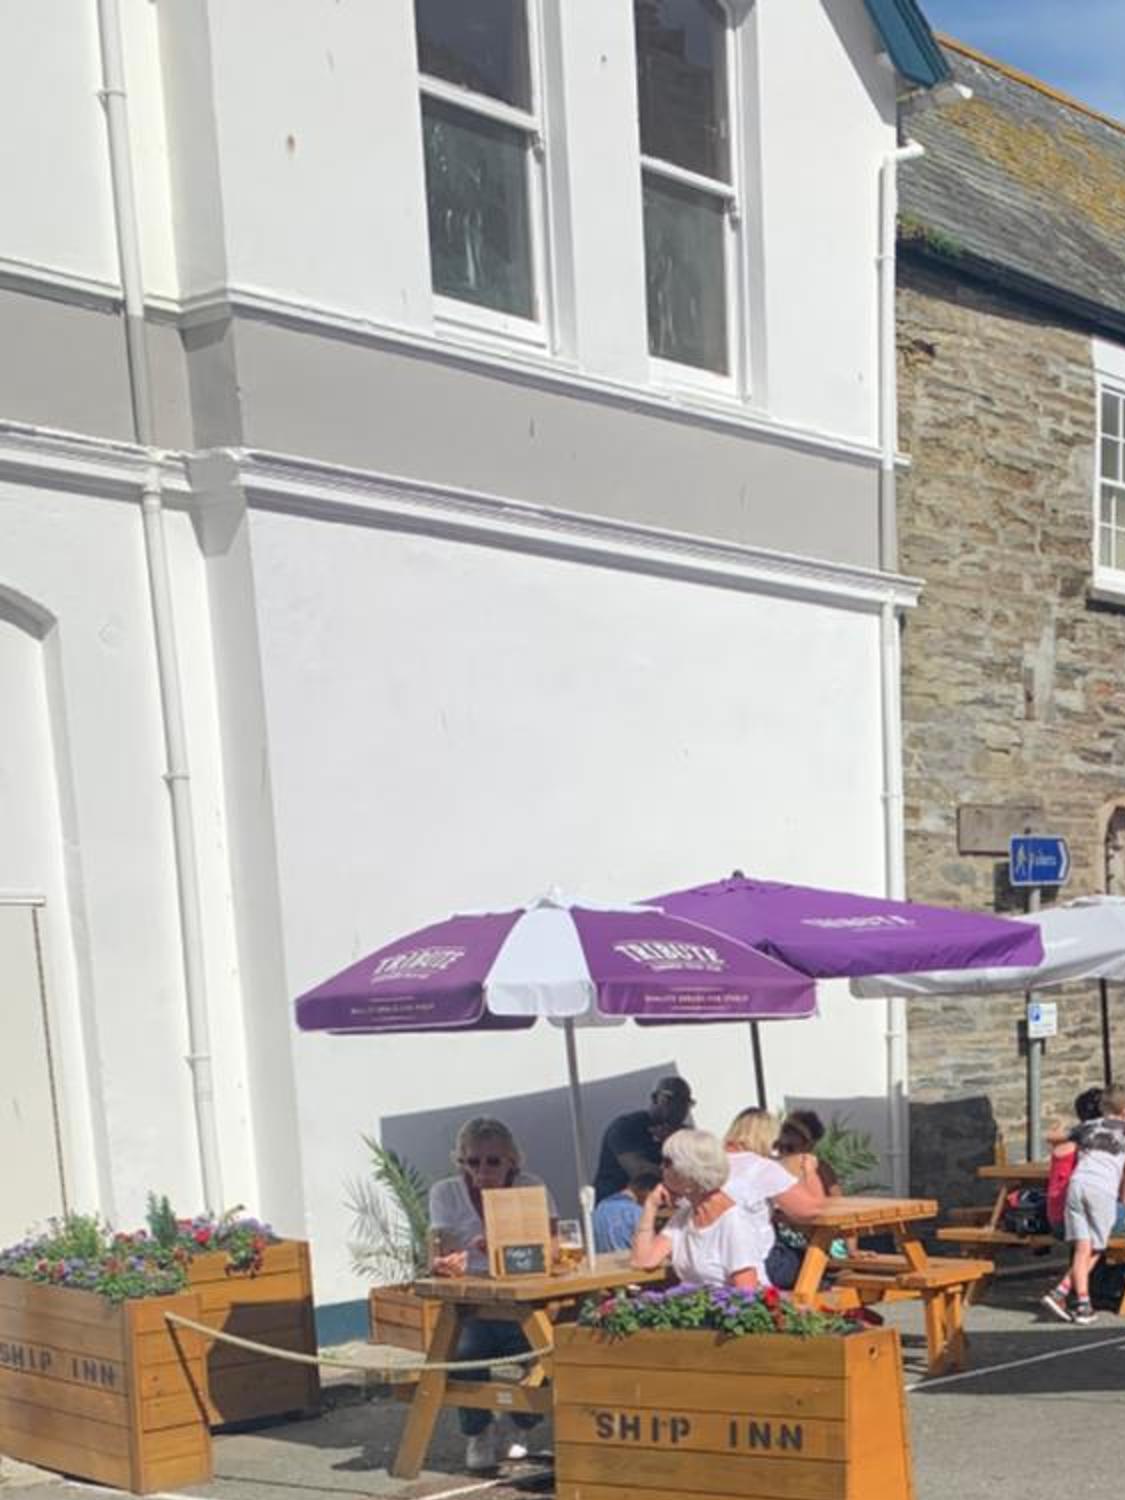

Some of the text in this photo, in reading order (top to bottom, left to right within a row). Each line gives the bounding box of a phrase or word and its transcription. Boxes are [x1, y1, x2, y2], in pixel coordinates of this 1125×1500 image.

[613, 942, 725, 963] TRIBUTE
[71, 1358, 115, 1386] INN
[595, 1411, 803, 1451] SHIP INN
